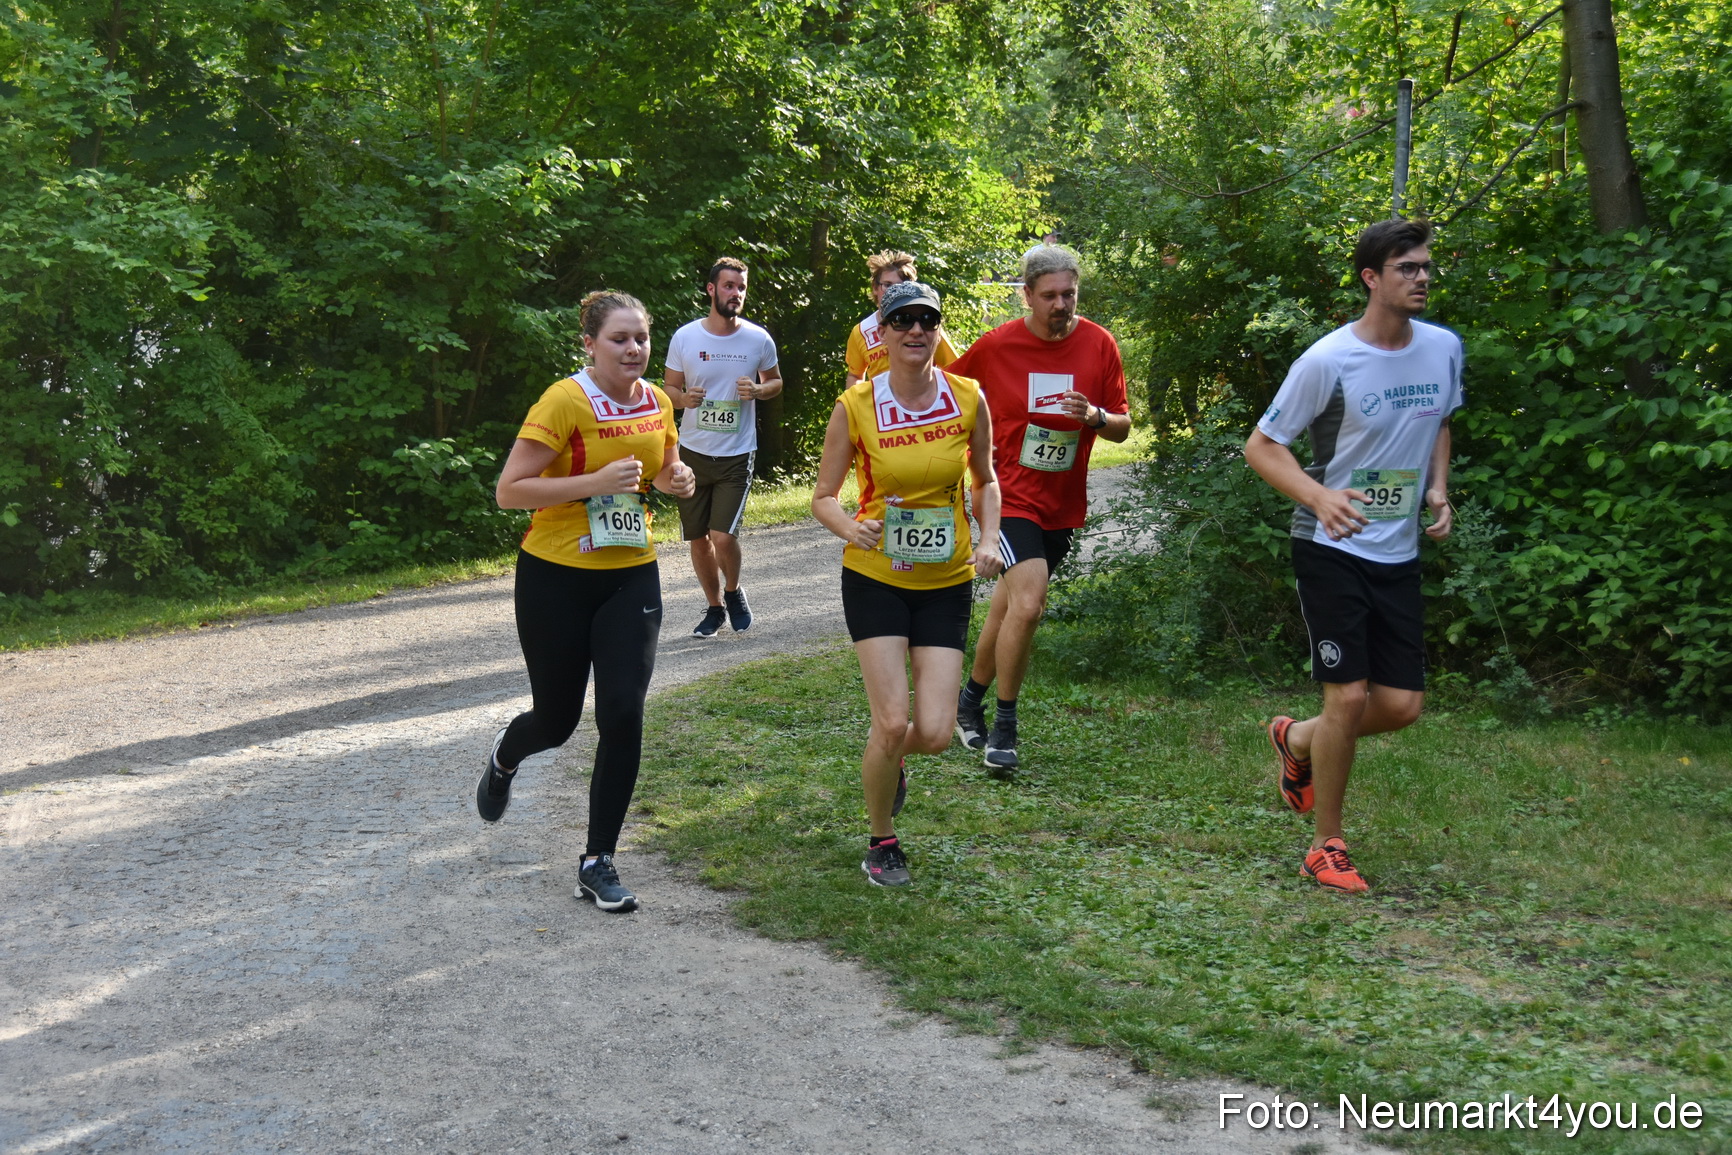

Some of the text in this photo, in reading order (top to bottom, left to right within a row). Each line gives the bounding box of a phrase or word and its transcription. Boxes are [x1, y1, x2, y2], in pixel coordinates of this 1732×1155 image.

[1384, 384, 1440, 400] HAUBNER
[1391, 397, 1434, 410] TREPPEN
[701, 410, 735, 424] 2148
[598, 419, 665, 439] MAX BÖGL
[878, 423, 966, 449] MAX BÖGL
[1033, 443, 1067, 461] 479
[598, 511, 642, 532] 1605
[893, 527, 947, 548] 1625
